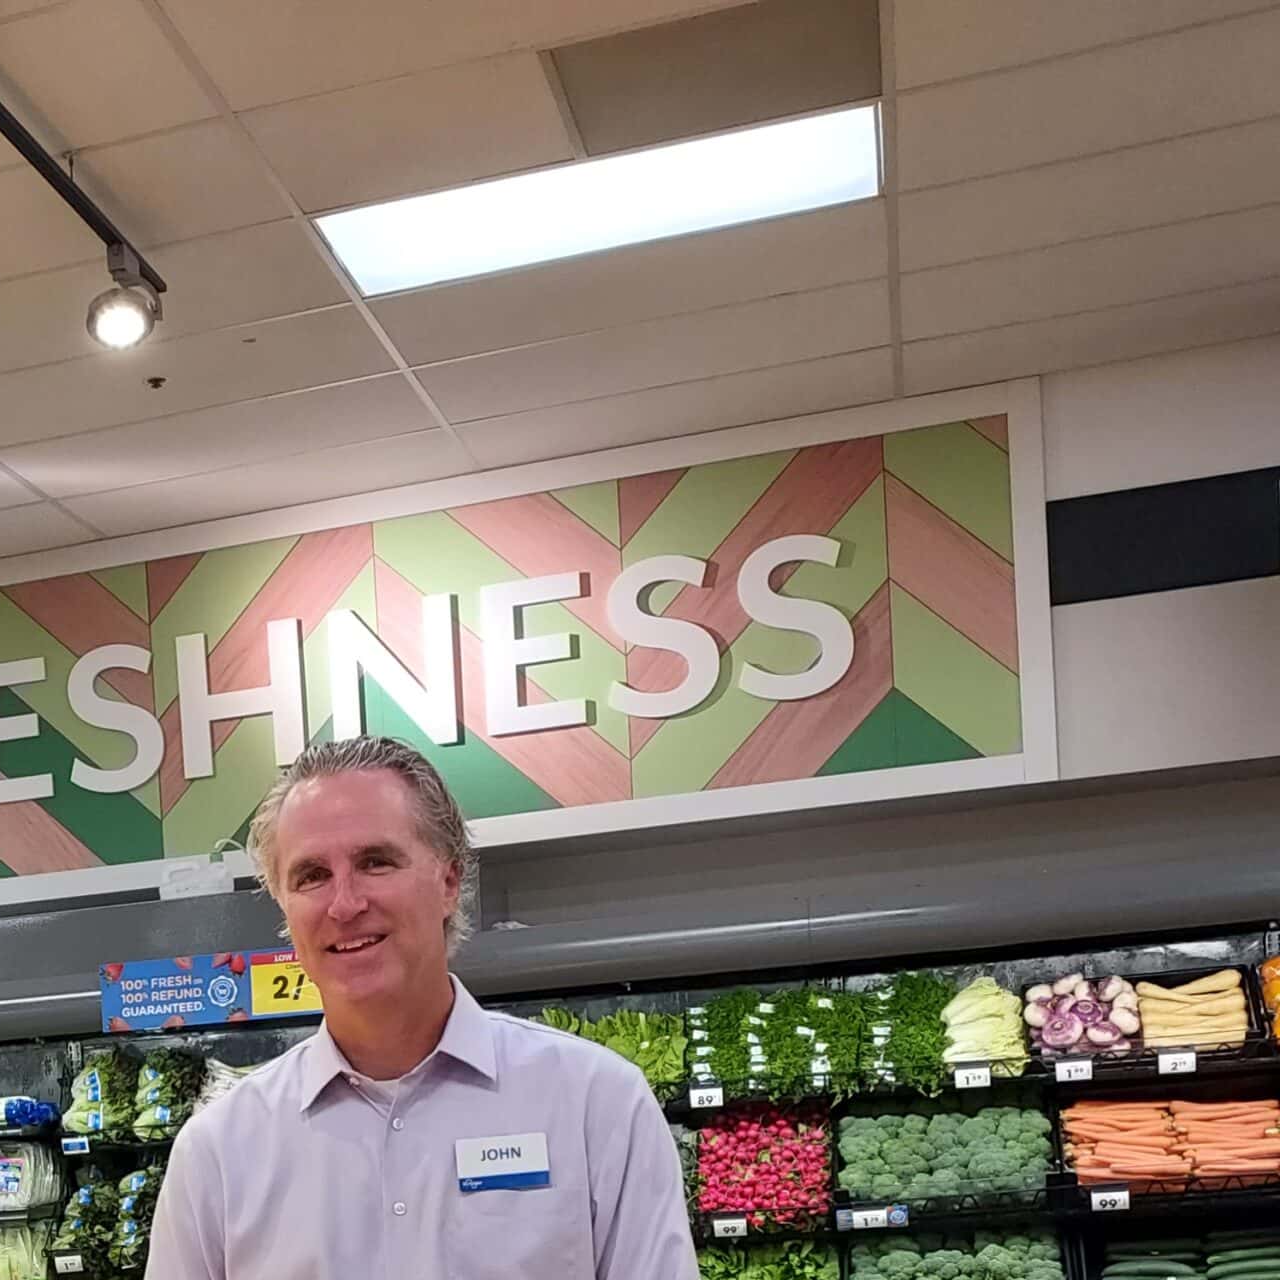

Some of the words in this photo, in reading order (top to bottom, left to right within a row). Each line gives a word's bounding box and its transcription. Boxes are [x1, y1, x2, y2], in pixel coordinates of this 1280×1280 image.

[151, 975, 192, 988] FRESH
[121, 1002, 206, 1017] GUARANTEED.
[480, 1147, 522, 1162] JOHN
